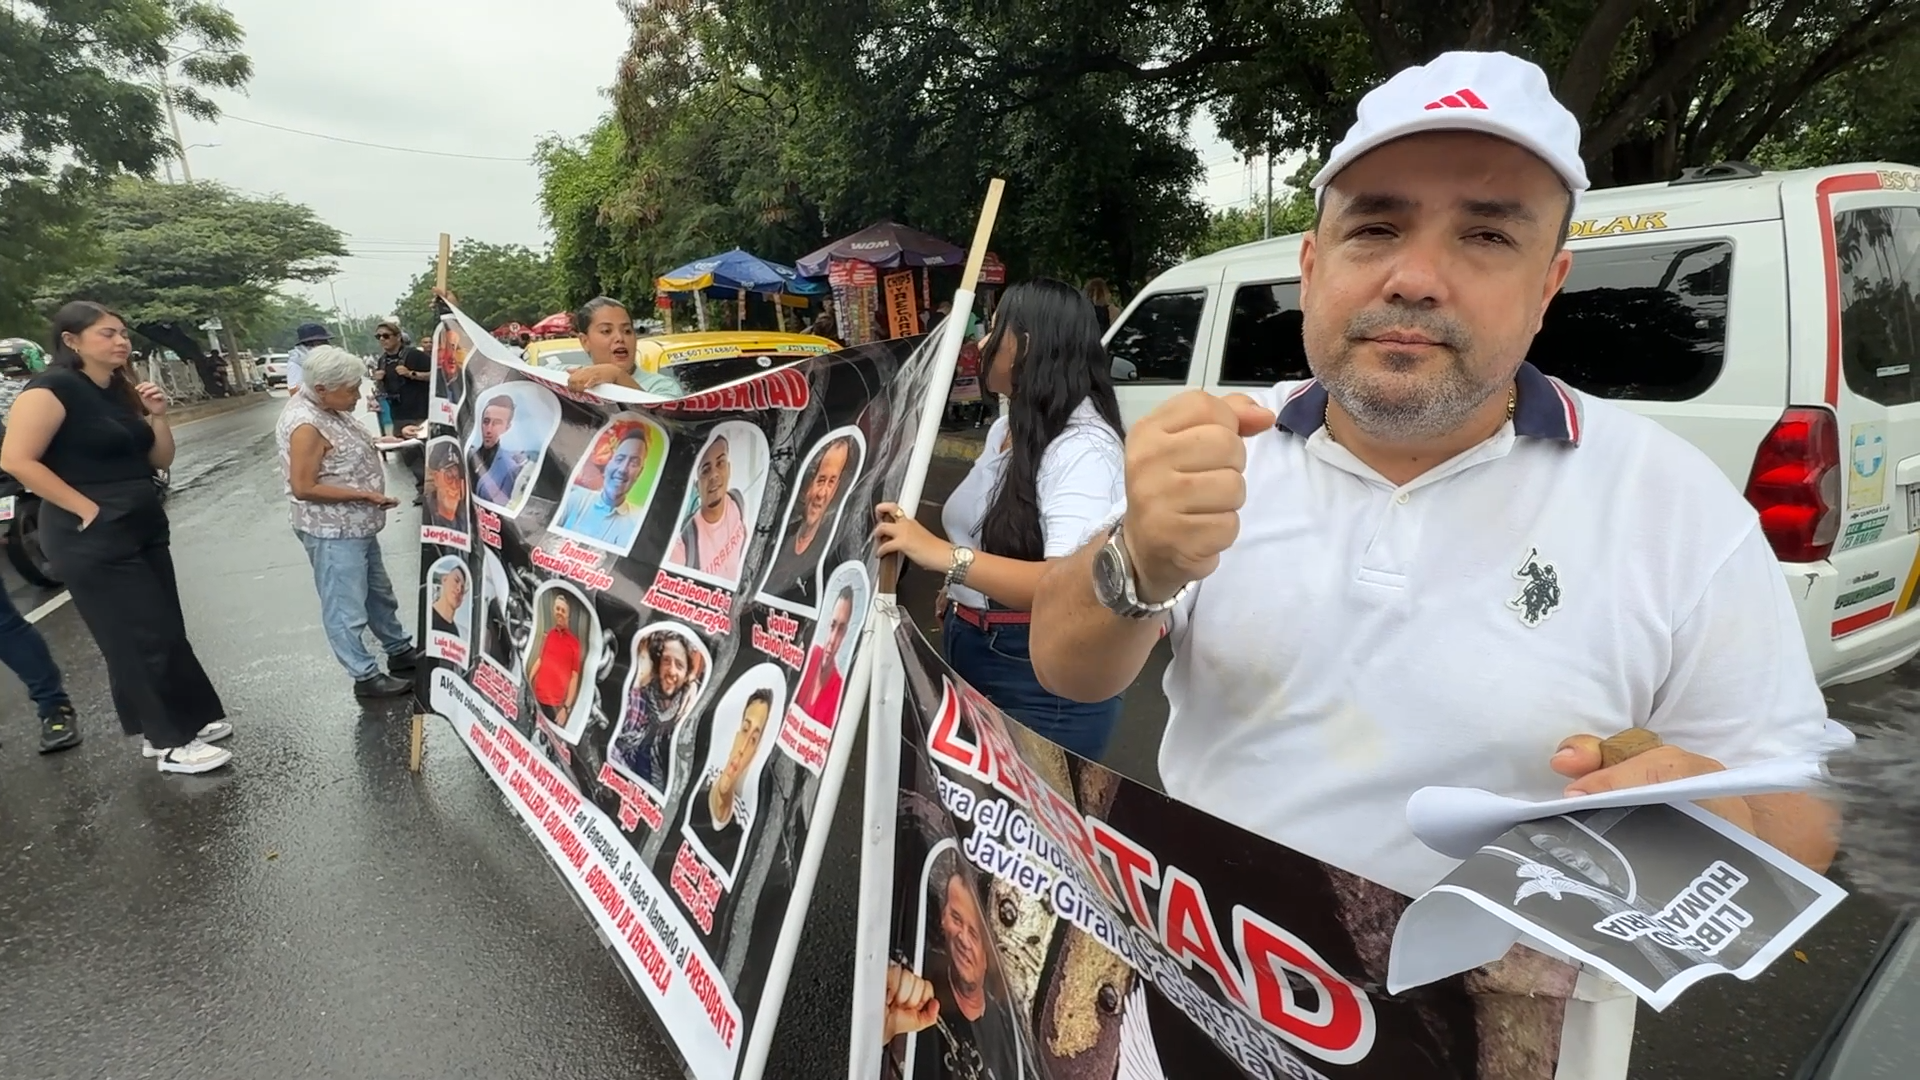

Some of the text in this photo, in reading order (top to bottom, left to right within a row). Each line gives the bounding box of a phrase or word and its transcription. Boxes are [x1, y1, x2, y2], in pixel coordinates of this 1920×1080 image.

[423, 528, 449, 542] Jorge
[559, 541, 599, 565] Danner
[531, 549, 614, 591] Gonzalo Barajas
[932, 765, 972, 816] ara
[976, 802, 1007, 833] el
[966, 831, 1049, 896] Javier
[527, 753, 582, 819] INJUSTAMENTE
[573, 810, 588, 831] en
[619, 860, 633, 888] Se
[629, 873, 650, 912] hace
[646, 896, 680, 956] llamado
[676, 944, 690, 970] al
[684, 952, 737, 1050] PRESIDENTE
[584, 863, 626, 922] GOBIERNO
[616, 905, 636, 936] DE
[626, 919, 674, 997] VENEZUELA
